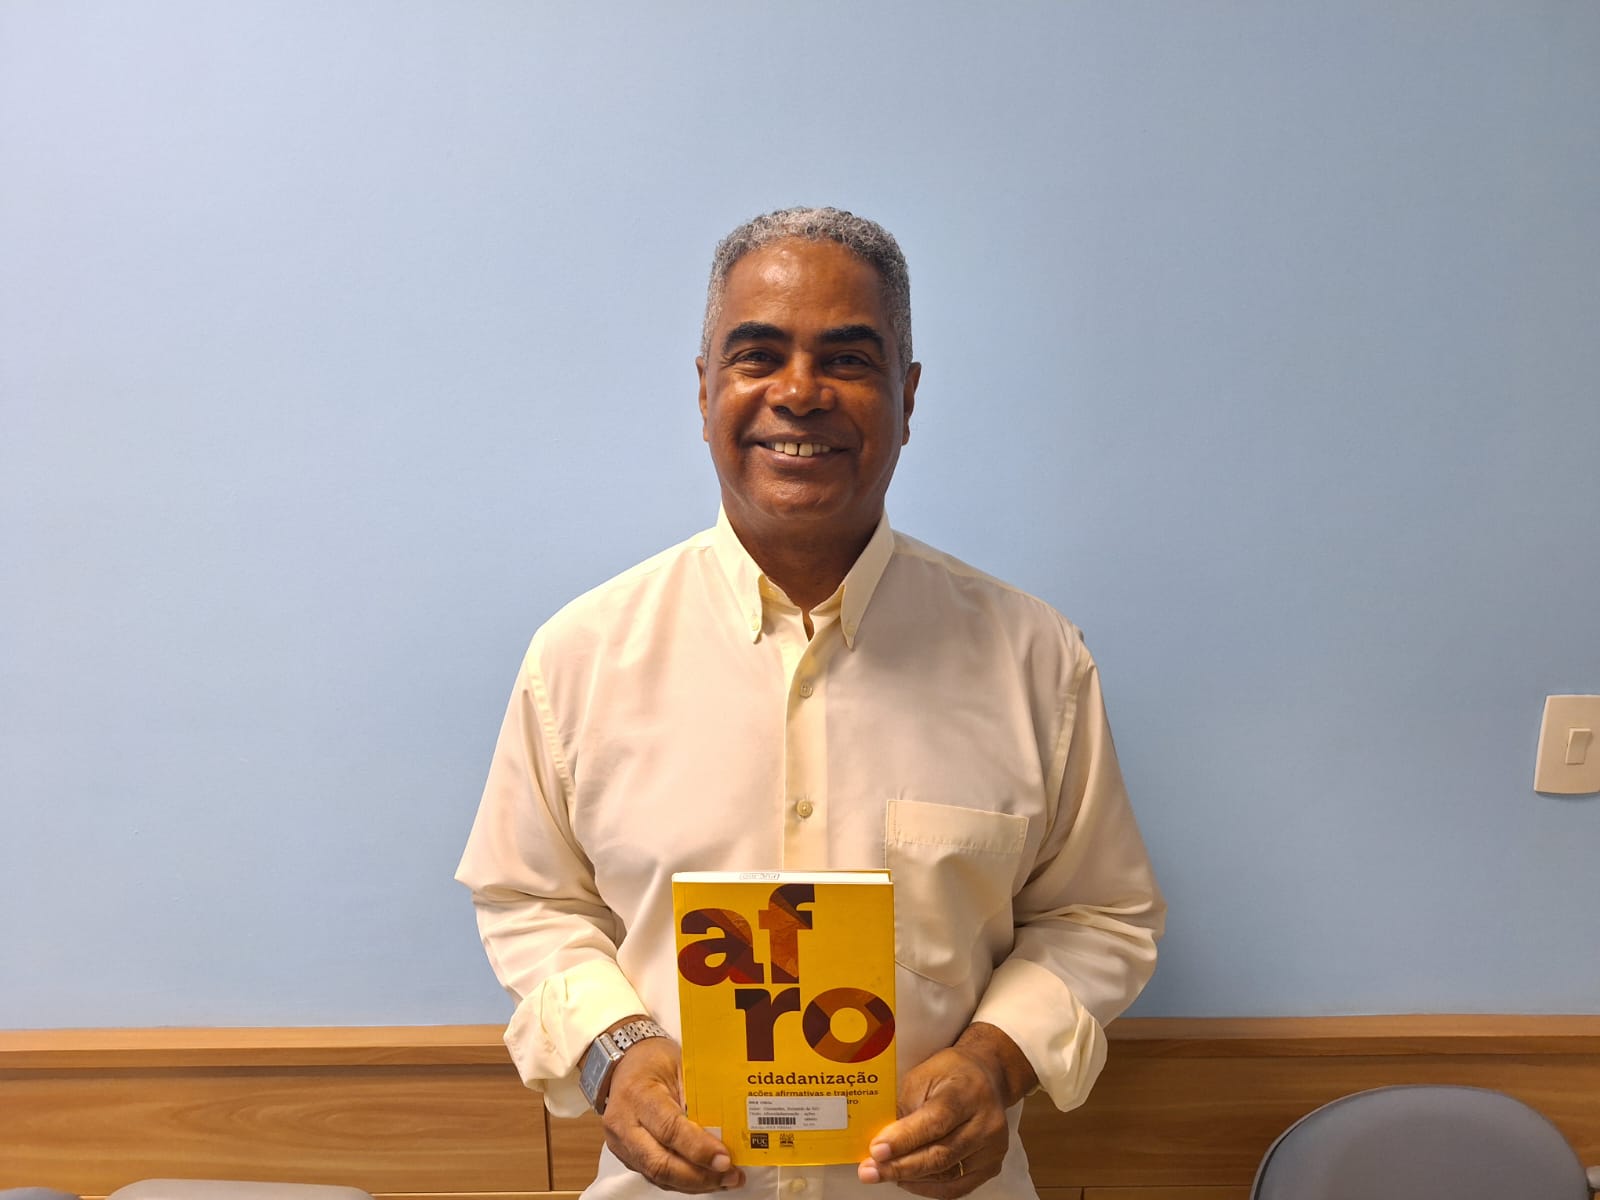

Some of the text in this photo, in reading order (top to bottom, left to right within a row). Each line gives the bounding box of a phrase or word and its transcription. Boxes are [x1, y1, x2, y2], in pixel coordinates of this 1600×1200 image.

[678, 883, 815, 986] af
[735, 987, 895, 1063] ro
[748, 1072, 878, 1089] cidadanização
[834, 1088, 878, 1098] trajetórias
